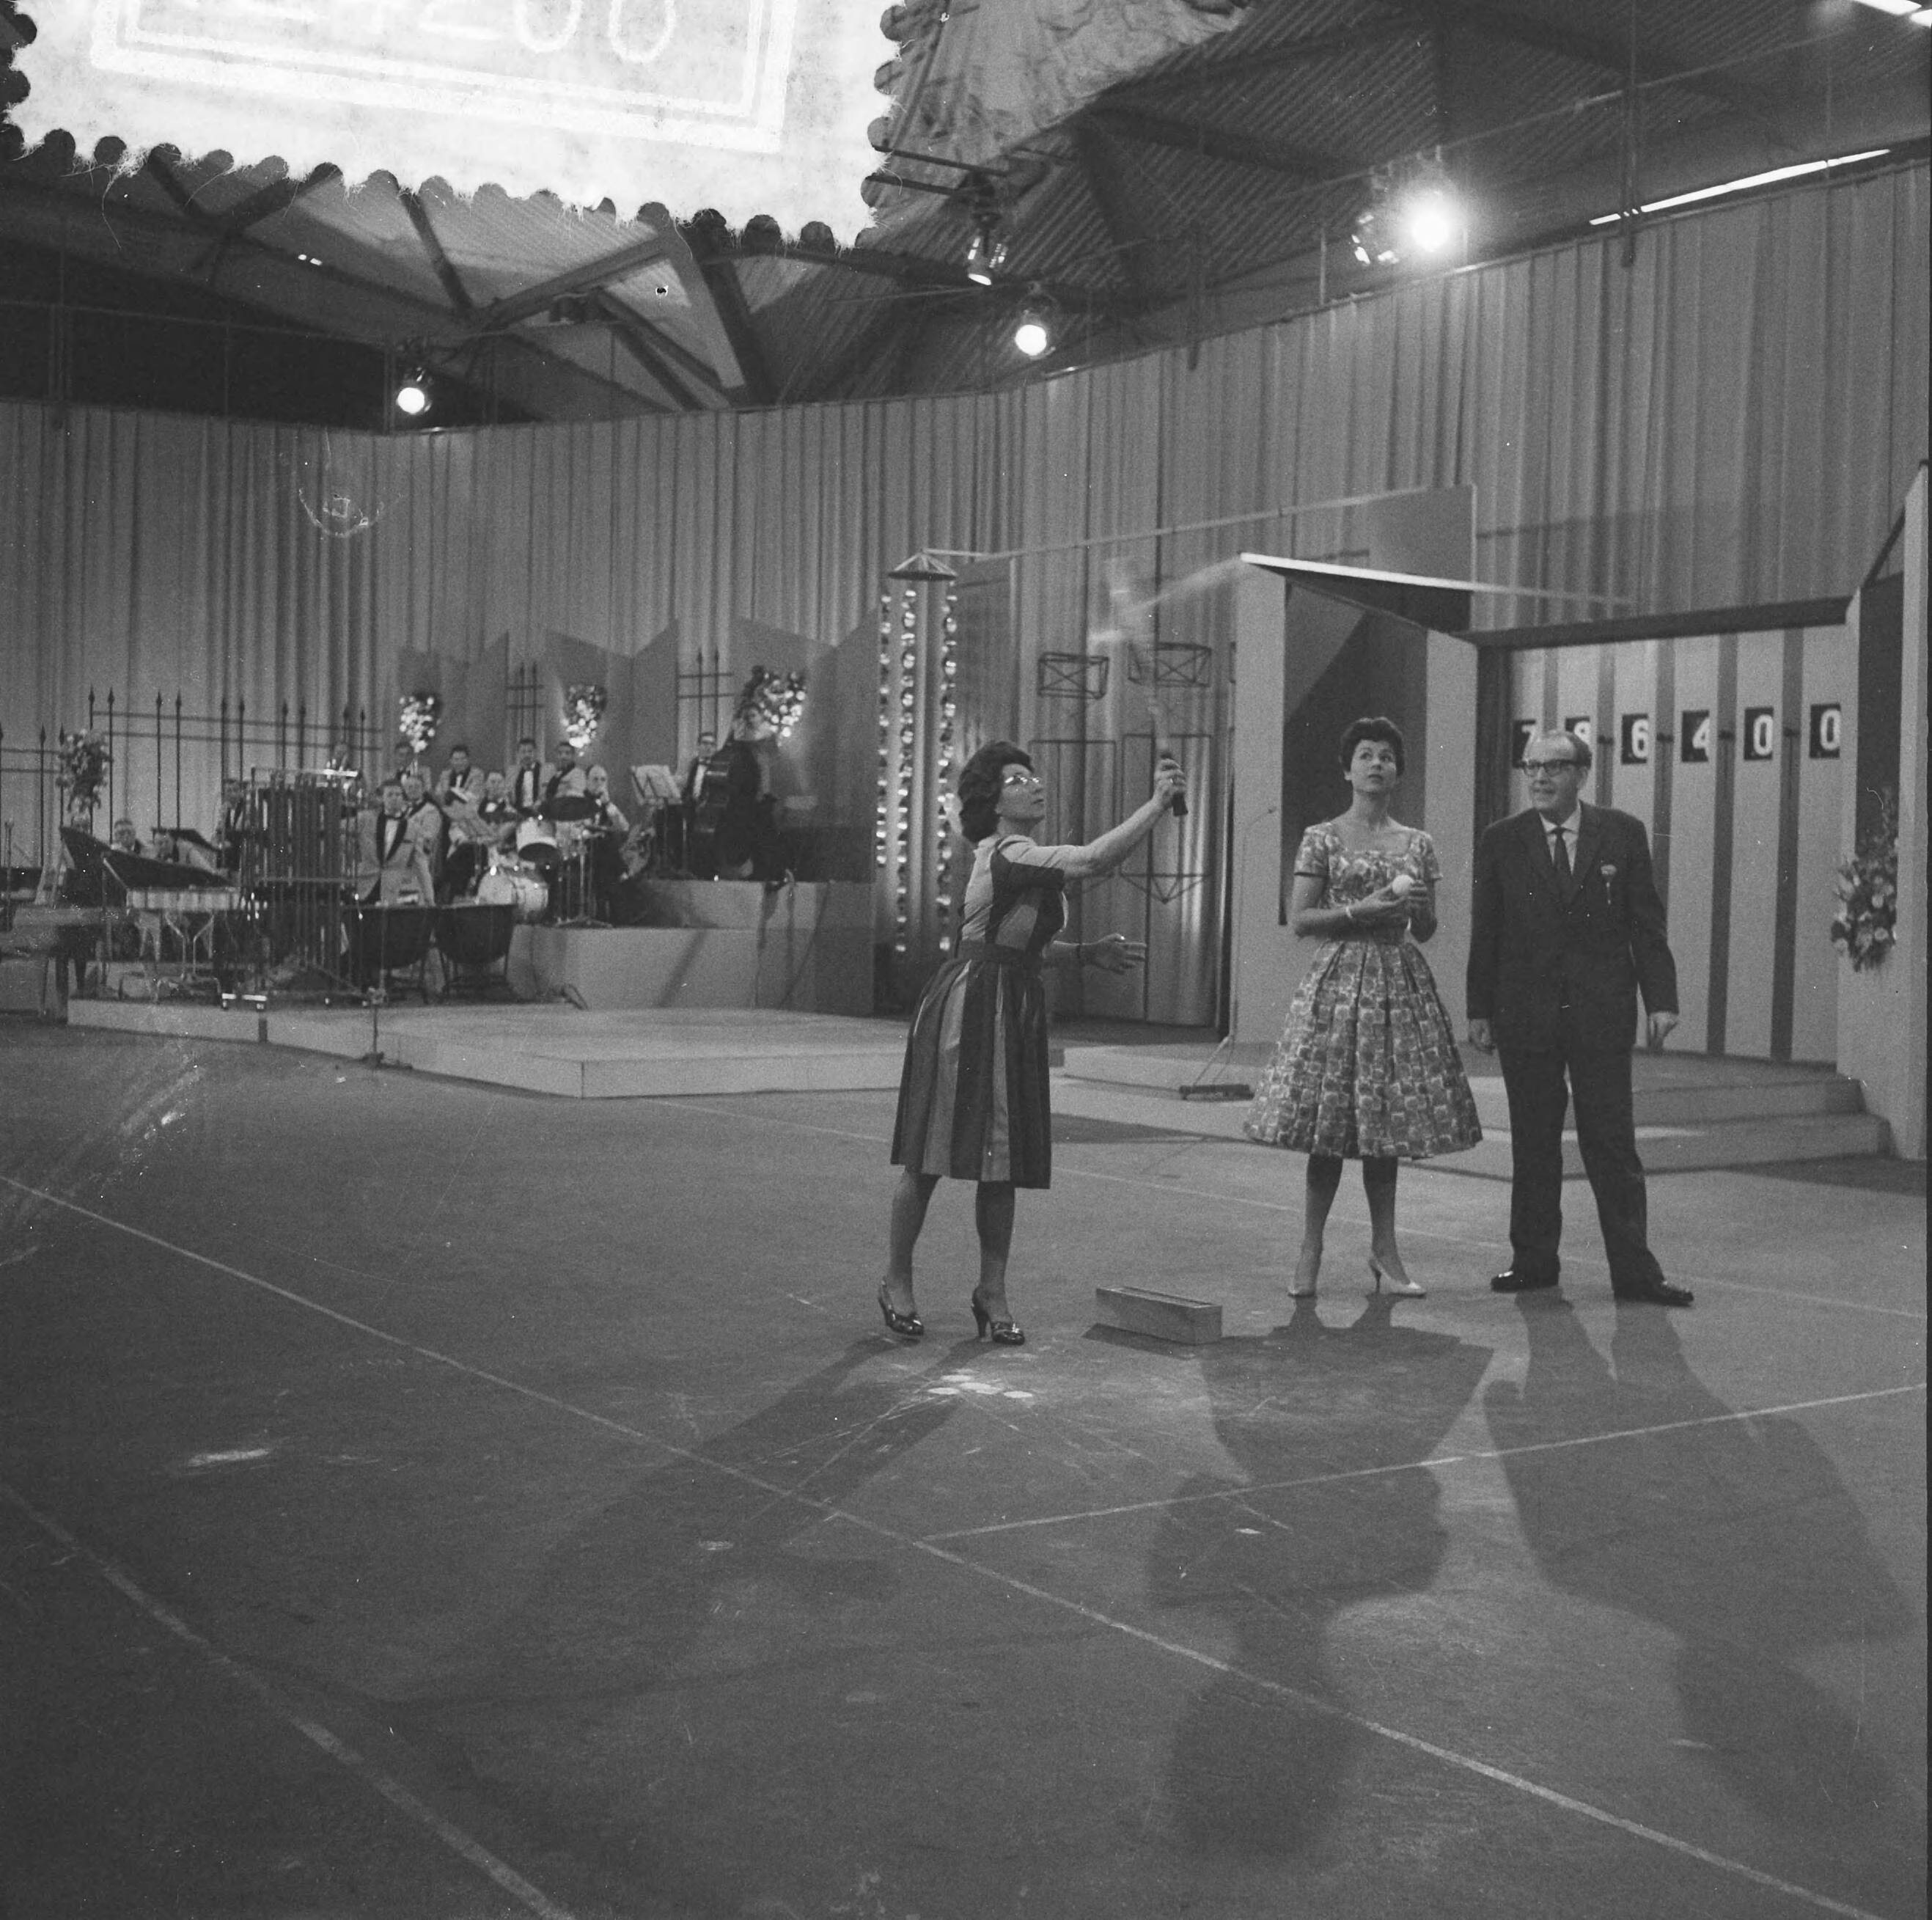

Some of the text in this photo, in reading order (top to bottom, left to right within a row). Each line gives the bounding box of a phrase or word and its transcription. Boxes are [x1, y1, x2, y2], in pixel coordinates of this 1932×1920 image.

[1631, 719, 1649, 758] 6
[1692, 717, 1710, 758] 4
[1753, 714, 1774, 755] 0
[1821, 709, 1841, 750] 0
